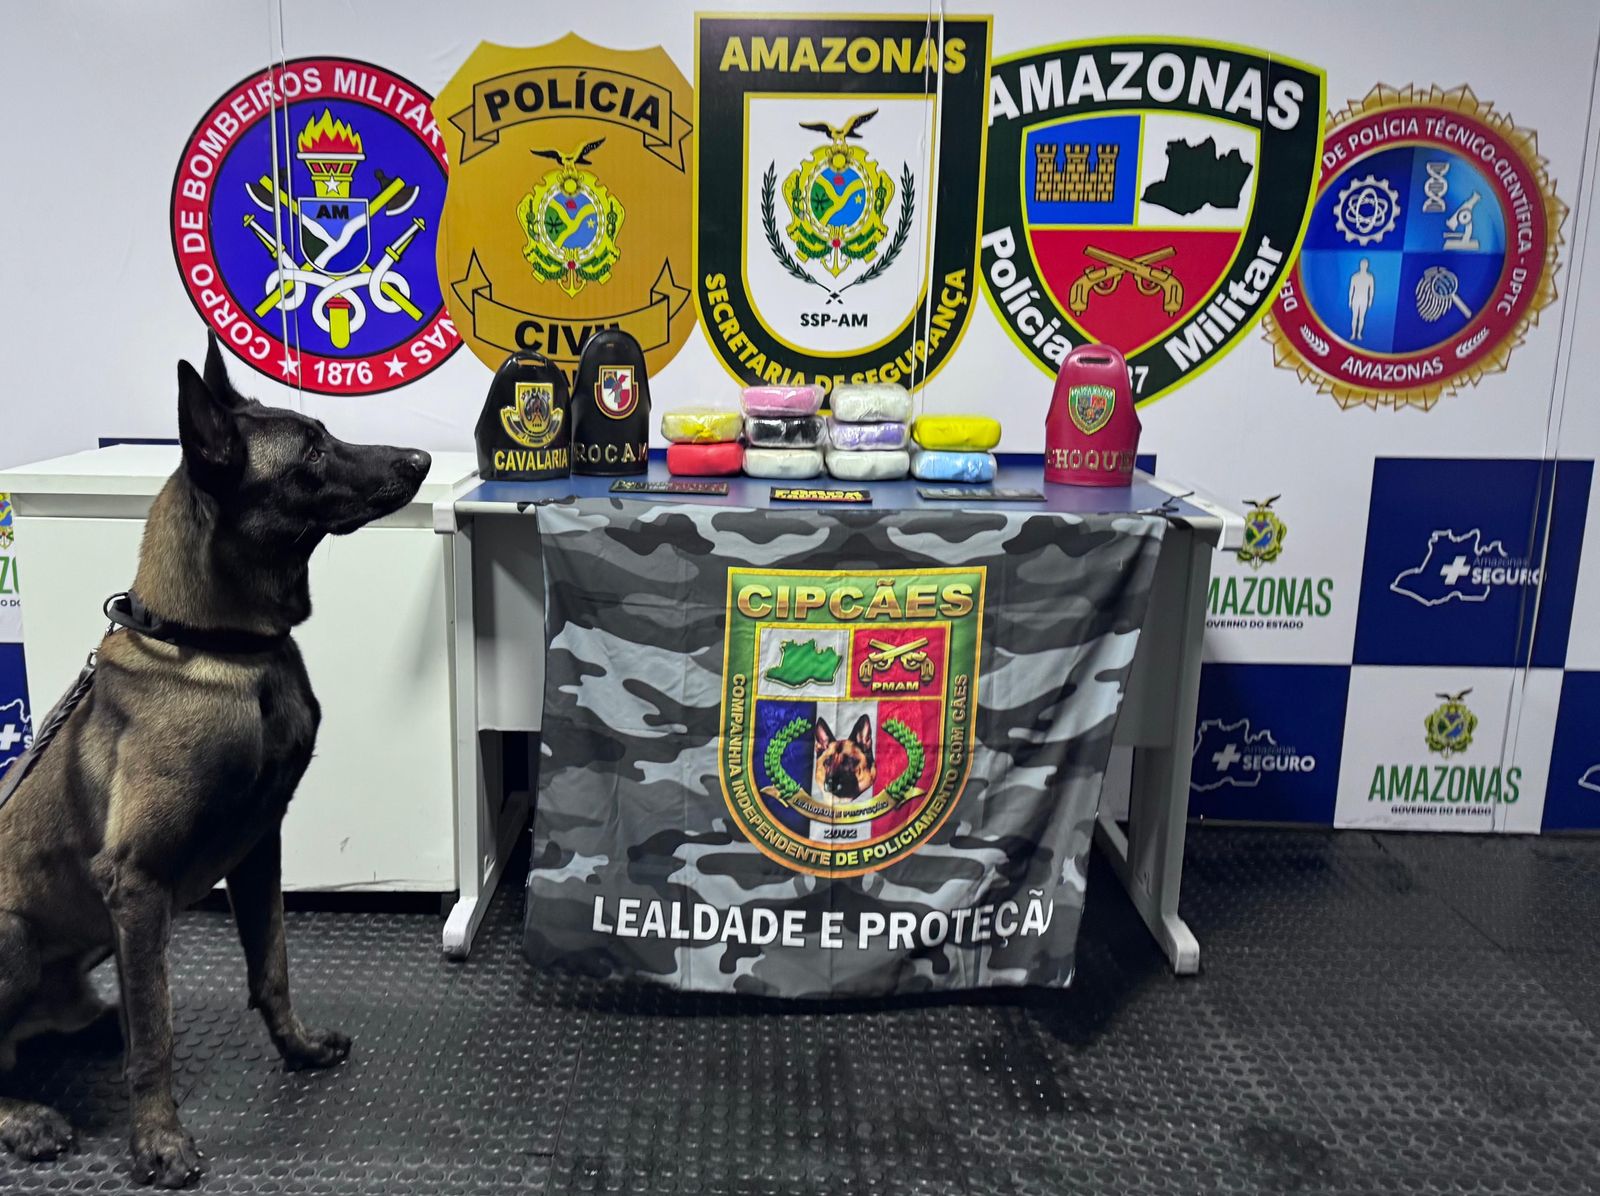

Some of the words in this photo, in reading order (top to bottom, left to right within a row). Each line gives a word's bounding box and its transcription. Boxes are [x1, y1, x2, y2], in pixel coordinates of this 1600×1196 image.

[720, 36, 966, 74] AMAZONAS
[484, 72, 659, 129] POLÍCIA
[988, 51, 1304, 130] AMAZONAS
[183, 68, 322, 201] BOMBEIROS
[317, 203, 350, 219] AM
[1323, 143, 1347, 169] DE
[1349, 118, 1419, 150] POLÍCIA
[1497, 268, 1527, 315] DPTC
[181, 211, 206, 253] DE
[191, 264, 271, 359] CORPO
[981, 226, 1073, 366] Polícia
[1164, 235, 1284, 372] Militar
[515, 320, 620, 355] CIV
[705, 273, 805, 386] SECRETARIA
[800, 313, 868, 327] SSP-AM
[314, 361, 373, 385] 1876
[1341, 356, 1443, 381] AMAZONAS
[494, 448, 568, 471] CAVALARIA
[736, 577, 974, 620] CIPCÃES
[1206, 620, 1247, 629] OVERNO
[1249, 620, 1264, 629] DO
[1266, 620, 1303, 630] ESTADO
[871, 681, 919, 692] PMAM
[728, 673, 747, 778] COMPANHIA
[949, 728, 965, 765] COM
[1243, 755, 1316, 772] SEGURO
[1367, 764, 1522, 804] AMAZONAS
[731, 779, 831, 866] INDEPENDENTE
[824, 828, 857, 839] 2002
[863, 770, 959, 862] POLICIAMENTO
[835, 851, 859, 866] DE
[592, 896, 806, 947] LEALDADE
[820, 911, 845, 949] E
